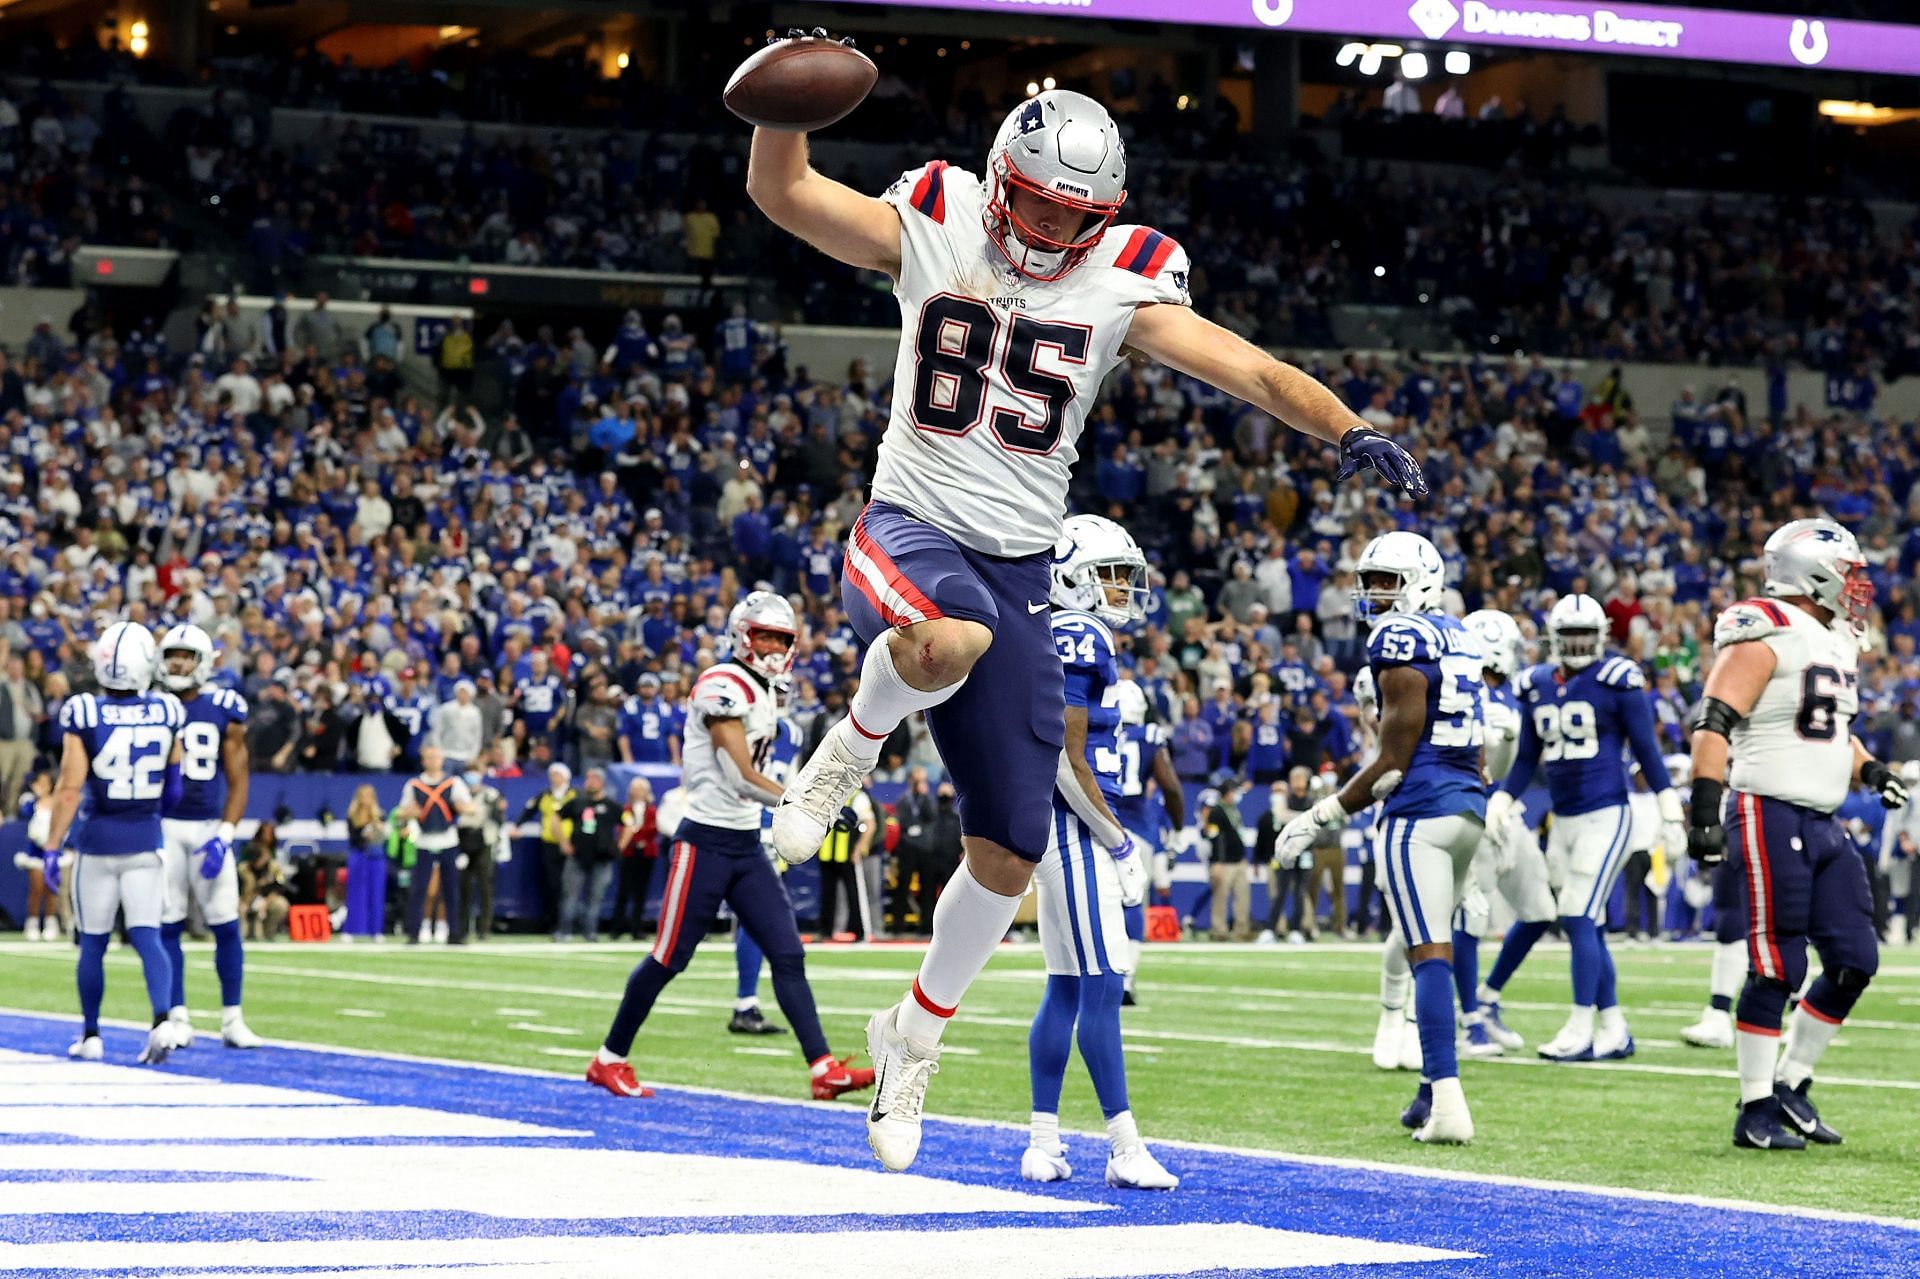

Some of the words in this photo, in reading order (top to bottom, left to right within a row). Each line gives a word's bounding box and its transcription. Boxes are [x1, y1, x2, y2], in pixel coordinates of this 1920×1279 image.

[1593, 10, 1684, 48] DIRECT
[1055, 181, 1090, 198] PATRIOTS
[909, 291, 1094, 457] 85
[1055, 633, 1097, 664] 34
[1381, 632, 1417, 662] 53
[641, 711, 661, 740] 2
[1532, 700, 1600, 762] 99
[92, 725, 173, 801] 42
[179, 721, 221, 781] 8
[1117, 740, 1144, 797] 1
[299, 913, 323, 940] 10
[1150, 913, 1178, 939] 20
